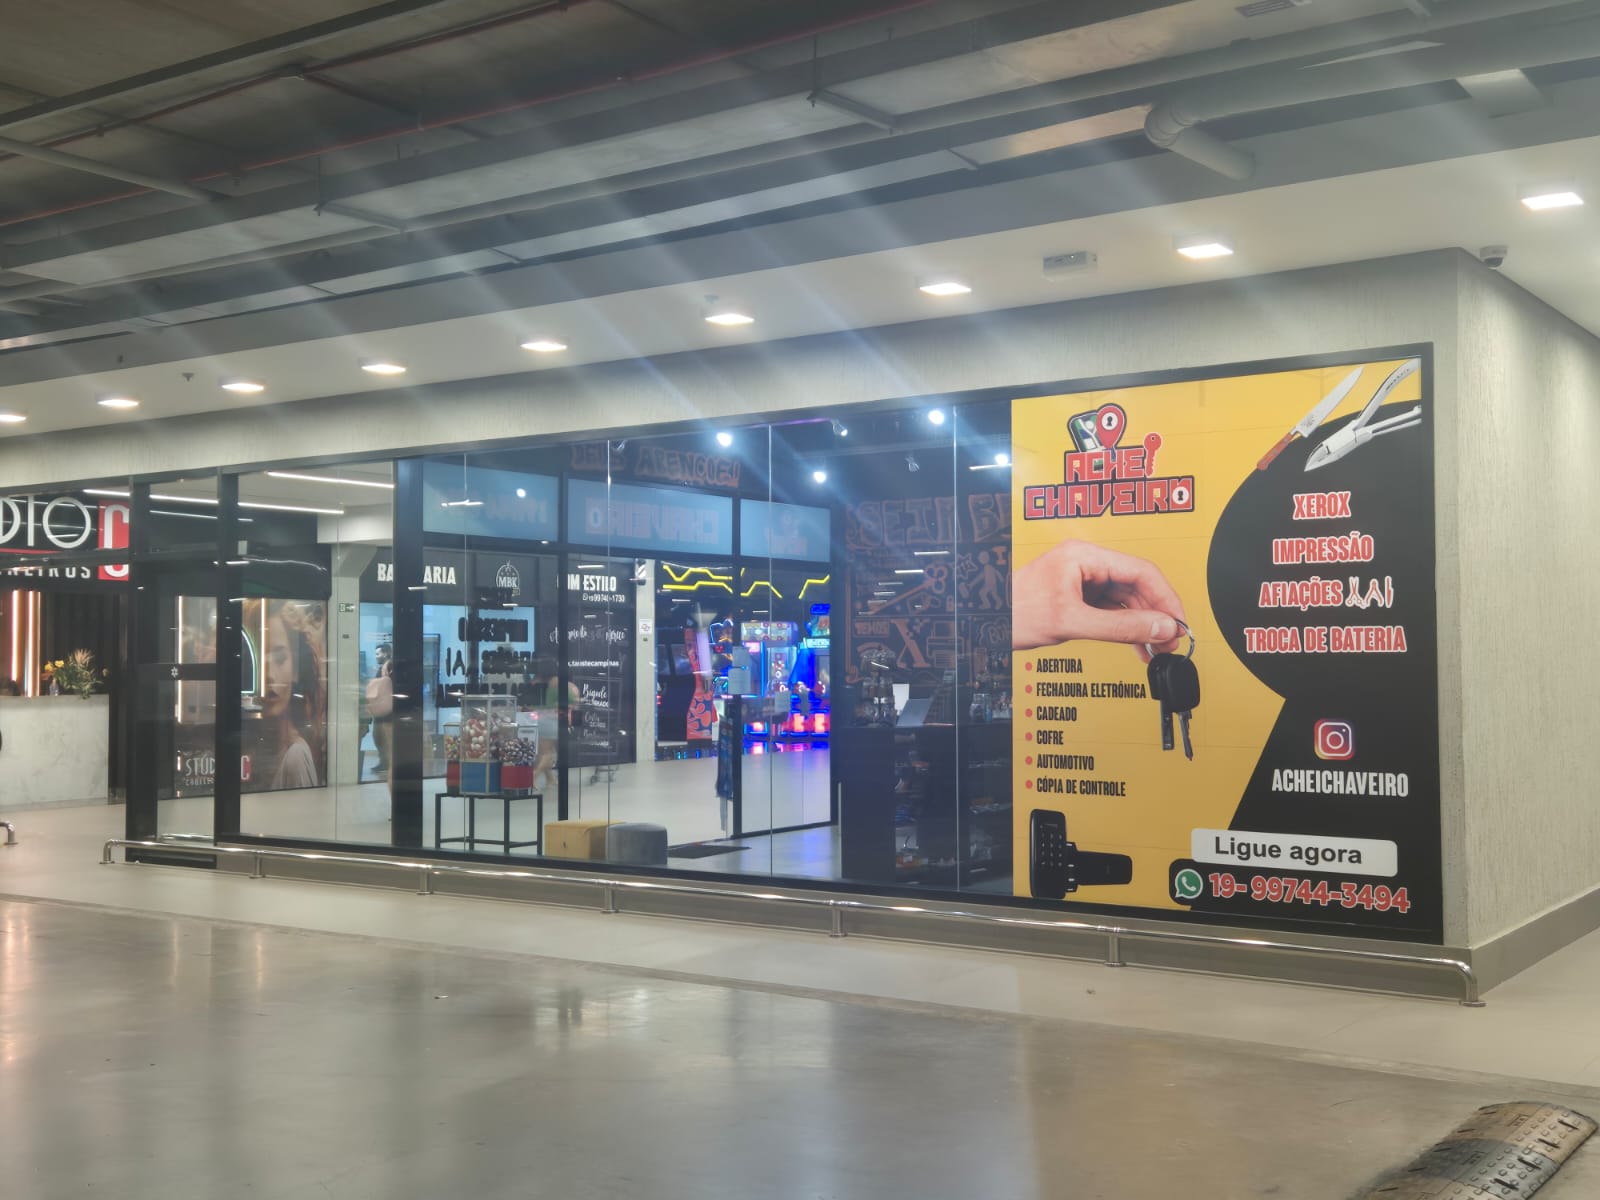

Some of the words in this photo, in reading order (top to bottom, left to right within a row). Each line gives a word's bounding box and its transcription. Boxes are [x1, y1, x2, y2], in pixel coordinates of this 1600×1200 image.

[1024, 476, 1194, 520] CHAVEIRO
[1293, 491, 1351, 520] XEROX
[1272, 531, 1374, 564] IMPRESSÃO
[583, 575, 617, 592] ESTILO
[1258, 576, 1343, 611] AFIAÇÕES
[1244, 627, 1301, 653] TROCA
[1304, 626, 1328, 653] DE
[1330, 626, 1407, 653] BATERIA
[1036, 658, 1083, 673] ABERTURA
[1036, 682, 1088, 697] FECHADURA
[1036, 706, 1077, 721] CADEADO
[1036, 730, 1064, 745] COFRE
[1036, 754, 1094, 771] AUTOMOTIVO
[1036, 775, 1063, 793] CÓPIA
[1066, 779, 1077, 794] DE
[1079, 780, 1126, 797] CONTROLE
[1271, 769, 1409, 797] ACHEICHAVEIRO
[1215, 836, 1282, 861] Ligue
[1290, 845, 1362, 866] agora
[1208, 873, 1247, 898] 19-
[1251, 875, 1411, 913] 99744-3494
